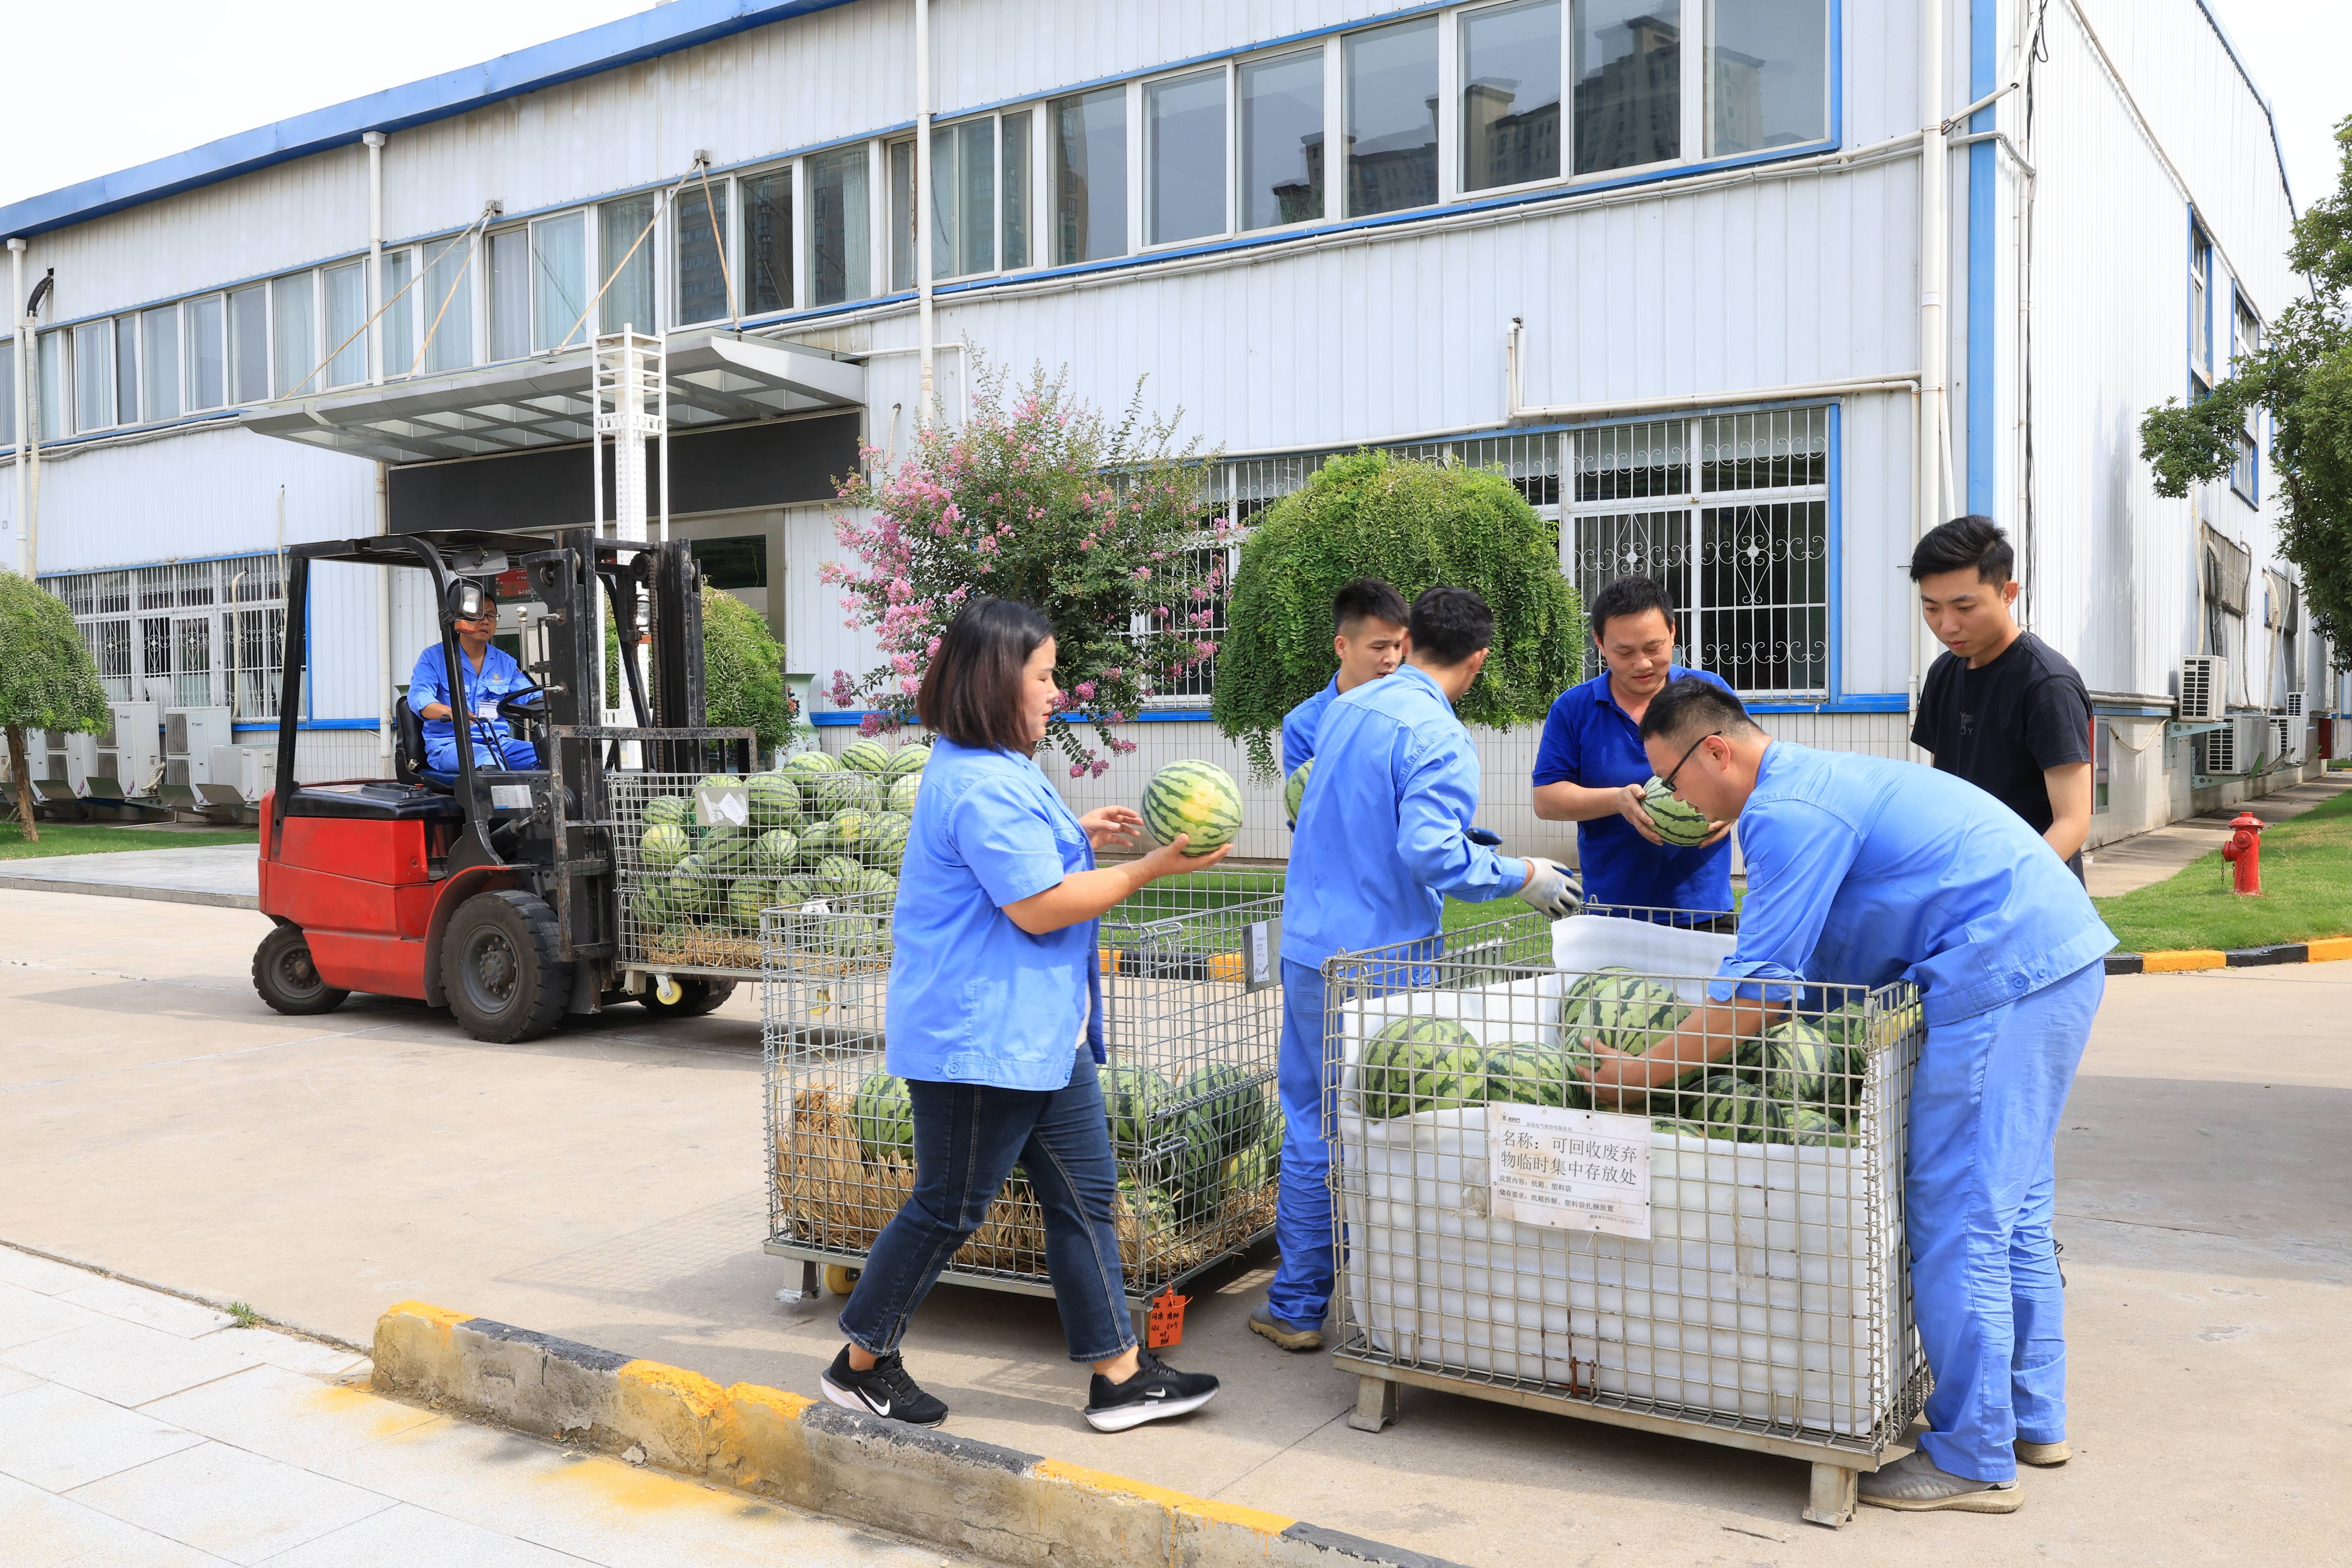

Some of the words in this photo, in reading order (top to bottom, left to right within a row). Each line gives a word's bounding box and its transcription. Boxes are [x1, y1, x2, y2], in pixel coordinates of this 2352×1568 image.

[1960, 727, 1973, 735] OY
[1526, 1122, 1572, 1132] 金冠电气股份有限公司
[1501, 1151, 1636, 1185] 物临时集中存放处
